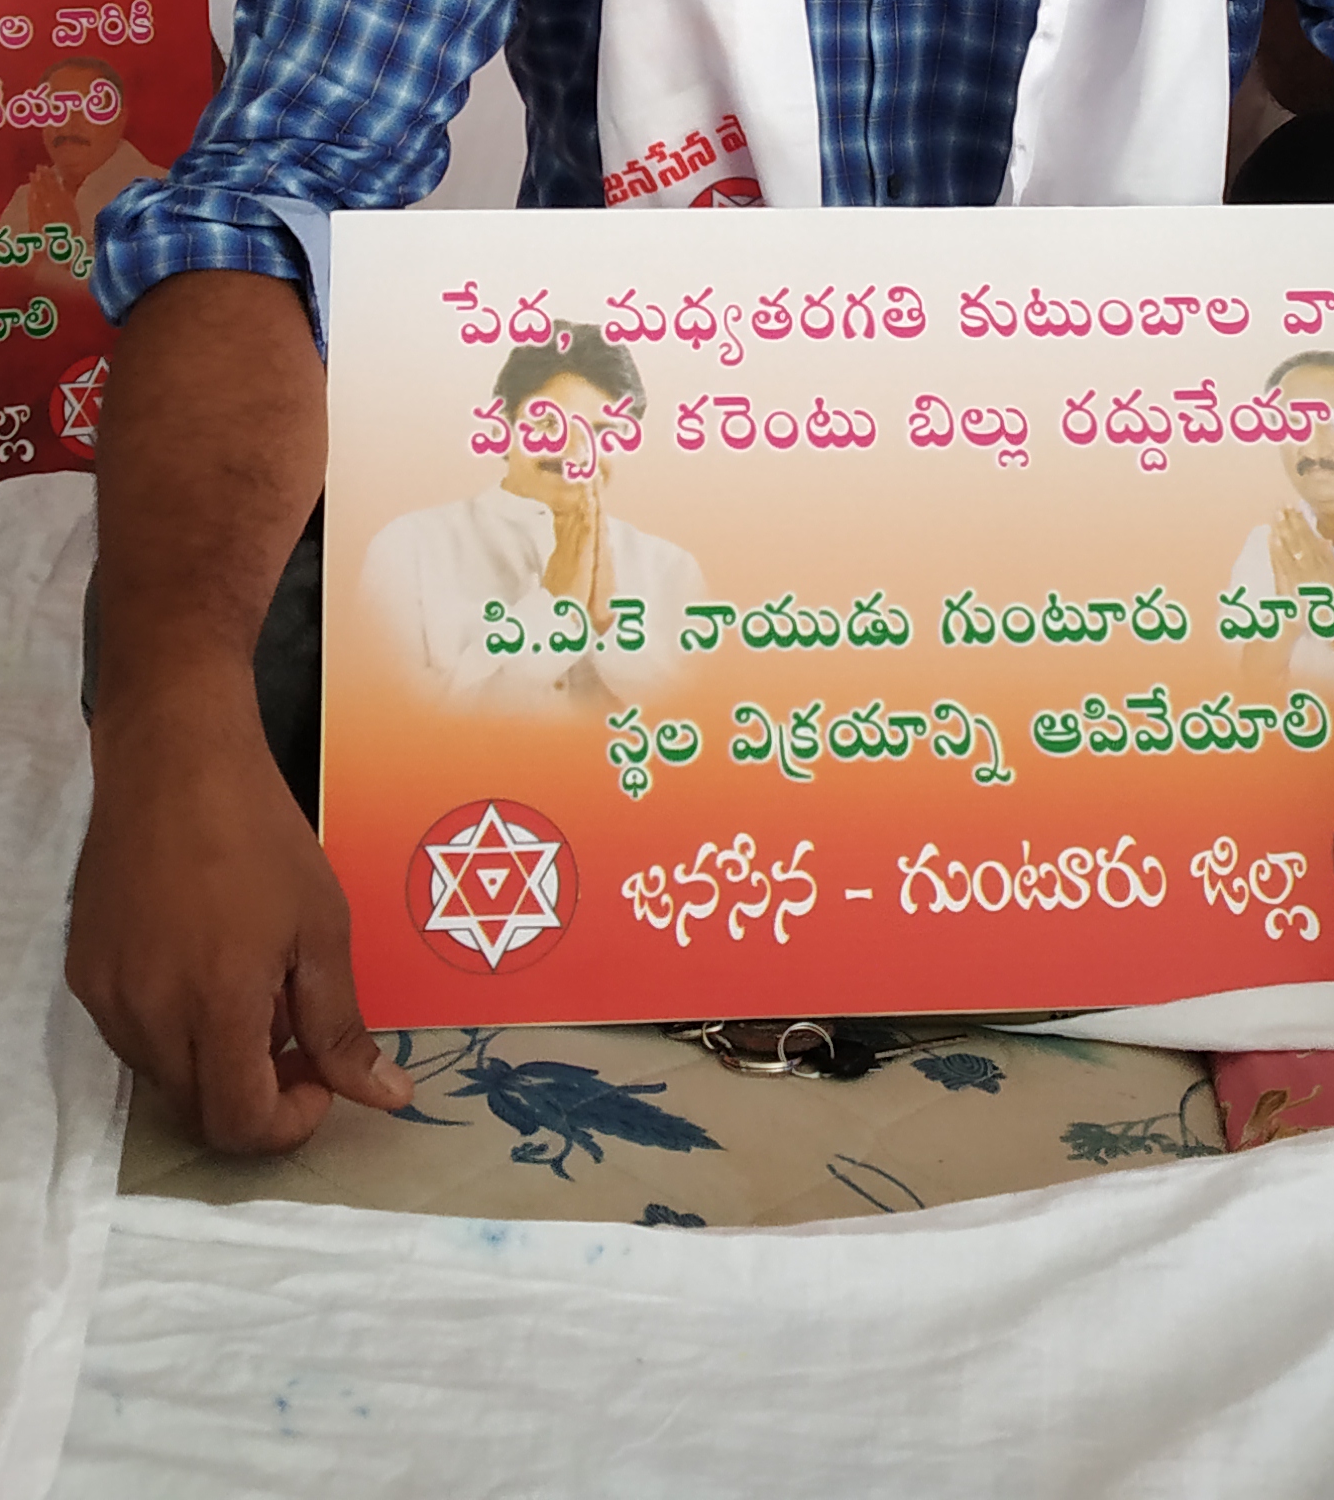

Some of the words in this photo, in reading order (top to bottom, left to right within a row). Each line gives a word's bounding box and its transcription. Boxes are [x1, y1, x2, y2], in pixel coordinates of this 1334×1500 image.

[442, 281, 572, 351] పేద,
[603, 285, 927, 367] మధ్యతరగతి
[959, 284, 1251, 338] కుటుంబాల
[470, 397, 643, 480] వచ్చిన
[675, 395, 877, 450] కరెంటు
[908, 395, 1030, 468] బిల్లు
[679, 591, 911, 651] నాయుడు
[942, 587, 1189, 645] గుంటూరు
[608, 708, 700, 798] స్థల
[731, 700, 1012, 783] విక్రయాన్ని
[1032, 687, 1329, 753] ఆపివేయాలి
[621, 832, 817, 947] జనసేన
[897, 834, 1167, 914] గుంటూరు
[1189, 835, 1321, 941] జిల్లా
